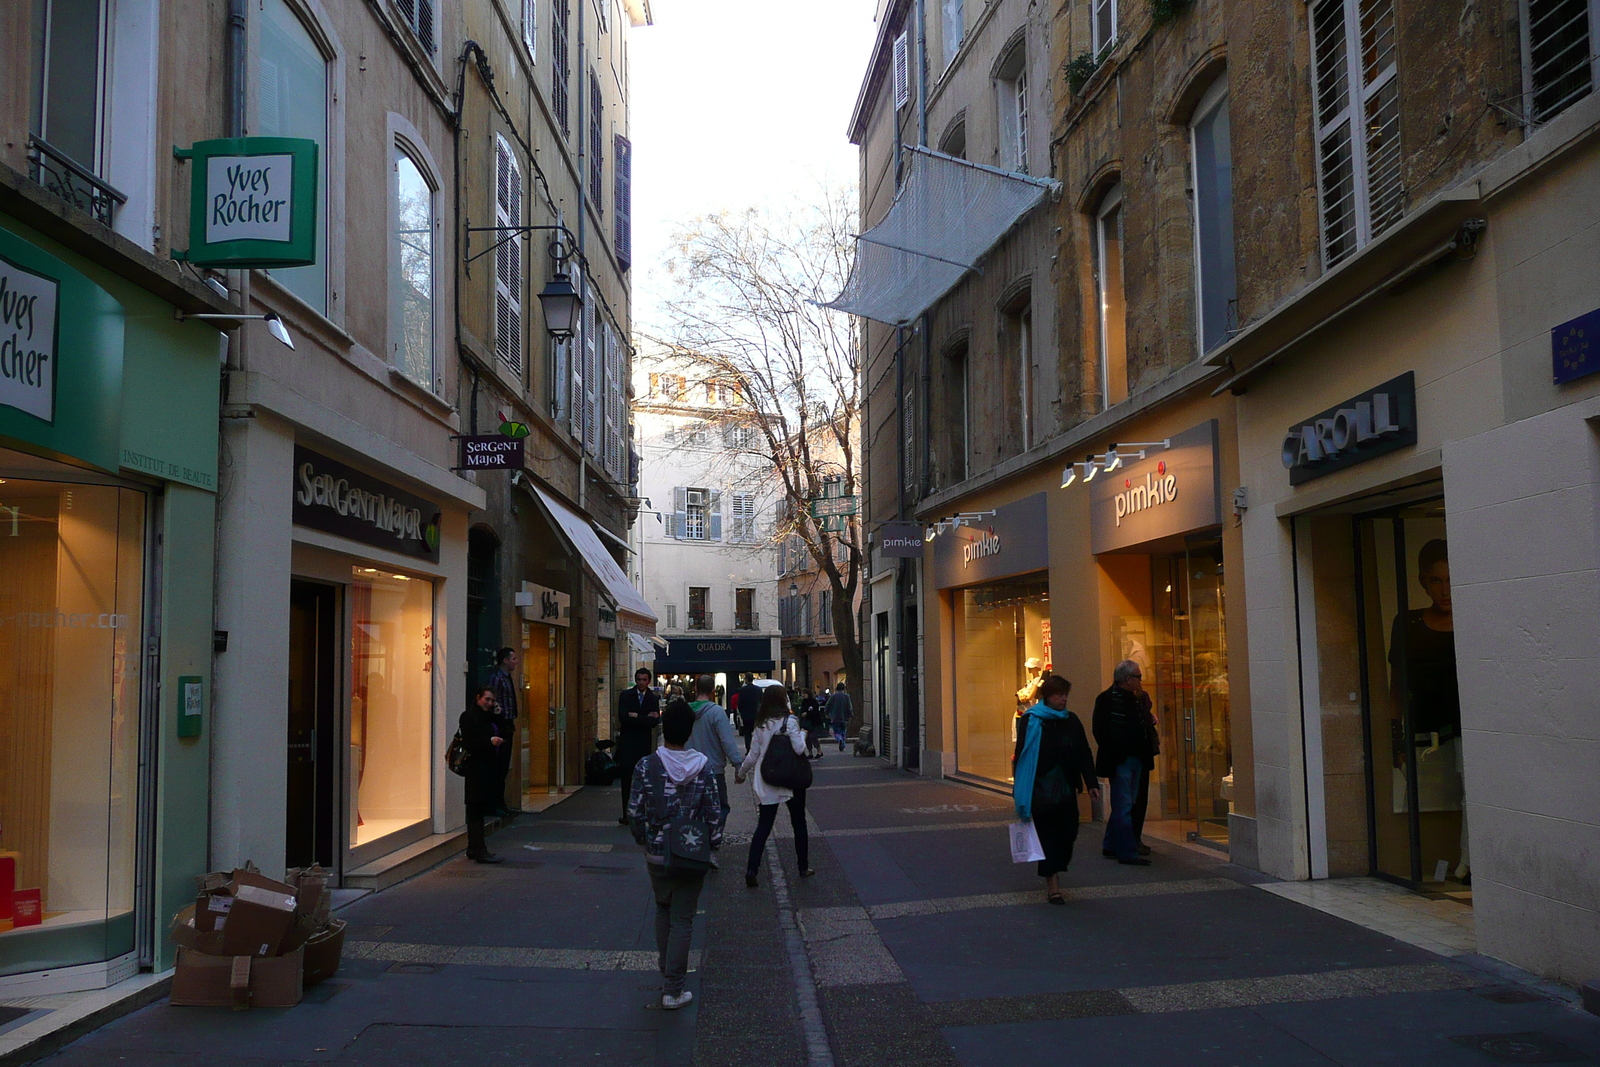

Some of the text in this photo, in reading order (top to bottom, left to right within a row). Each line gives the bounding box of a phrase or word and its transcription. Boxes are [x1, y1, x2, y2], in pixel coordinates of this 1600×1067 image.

[227, 164, 270, 199] Yves
[212, 194, 286, 227] Rocher
[1281, 392, 1399, 470] CAROLL
[123, 449, 165, 473] INSTITUT
[168, 463, 179, 478] DE
[1113, 460, 1178, 527] pimkie
[883, 535, 921, 549] pimkie
[963, 525, 1000, 568] pimkie
[696, 642, 732, 652] QUADRA
